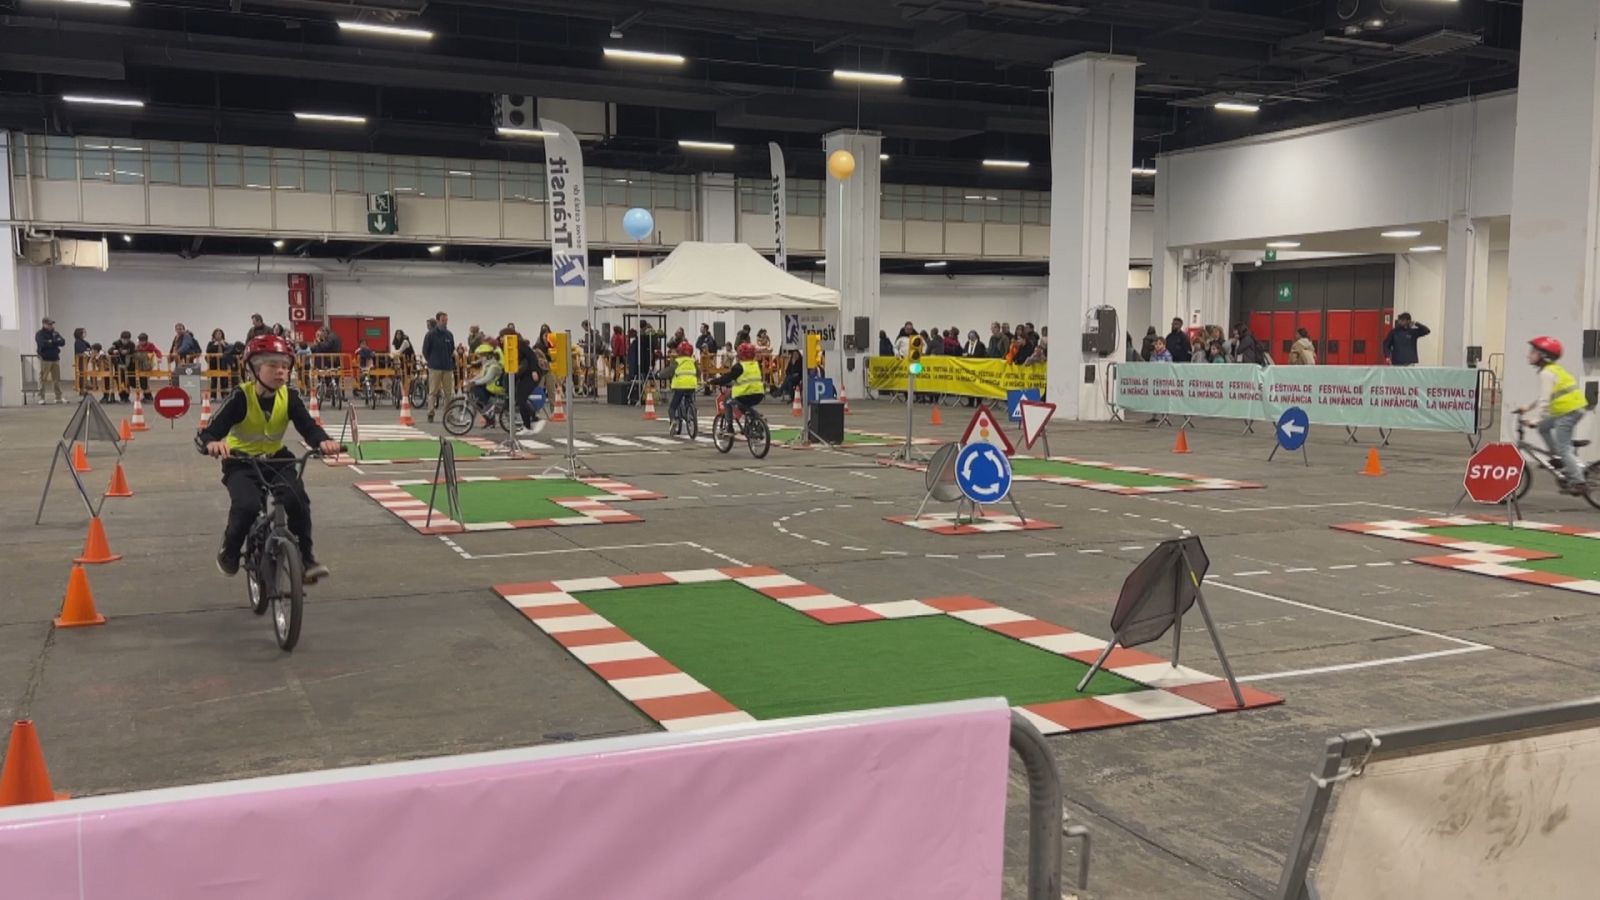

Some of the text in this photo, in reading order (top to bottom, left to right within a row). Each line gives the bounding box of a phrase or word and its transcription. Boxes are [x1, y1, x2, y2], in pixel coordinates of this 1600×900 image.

[1189, 380, 1223, 390] FESTIVAL DE
[1270, 383, 1312, 393] FESTIVAL DE
[1319, 384, 1363, 395] FESTIVAL DE
[815, 381, 826, 401] P
[1188, 390, 1195, 398] LA
[1370, 386, 1418, 396] FESTIVAL DE
[1427, 388, 1476, 399] FESTIVAL D
[1269, 393, 1312, 404] LA INFÀNCIA
[1319, 395, 1363, 406] LA INFÀNCIA
[1370, 396, 1418, 409] LA INFÀNCIA
[1427, 400, 1436, 409] LA
[1470, 464, 1519, 480] STOP
